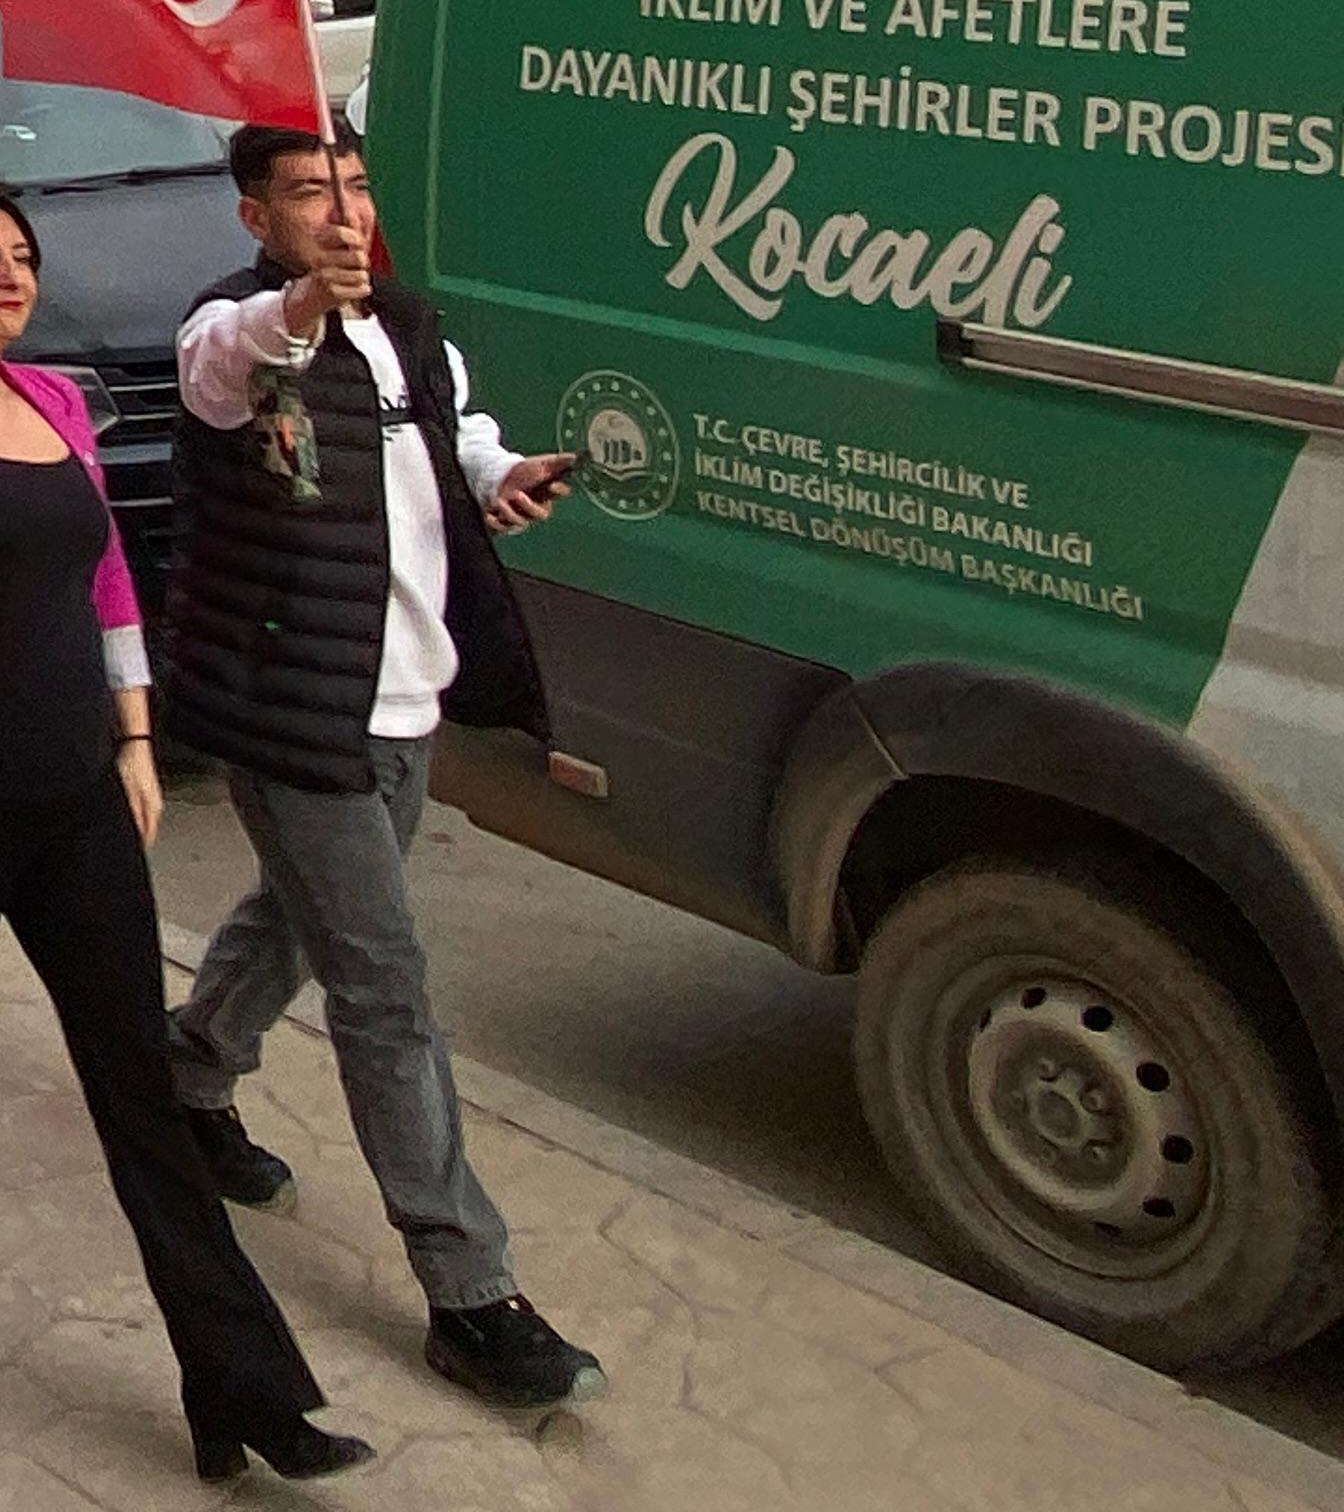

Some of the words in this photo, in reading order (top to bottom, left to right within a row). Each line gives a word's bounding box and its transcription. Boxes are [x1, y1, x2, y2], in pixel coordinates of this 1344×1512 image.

[518, 44, 773, 117] DAYANIKLI
[785, 63, 1063, 148] ŞEHİRLER
[1082, 95, 1344, 178] PROJES
[643, 131, 1075, 329] Kocaeli
[694, 447, 764, 489] İKLİM
[767, 468, 927, 528] DEĞİŞİKLİĞİ
[931, 507, 1094, 568] BAKANLIĞI
[740, 425, 830, 469] ÇEVRE,
[835, 444, 988, 500] ŞEHİRCİLİK
[992, 479, 1031, 509] VE
[695, 491, 807, 539] KENTSEL
[810, 518, 956, 574] DÖNÜŞÜM
[960, 554, 1147, 623] BAŞKANLIĞI
